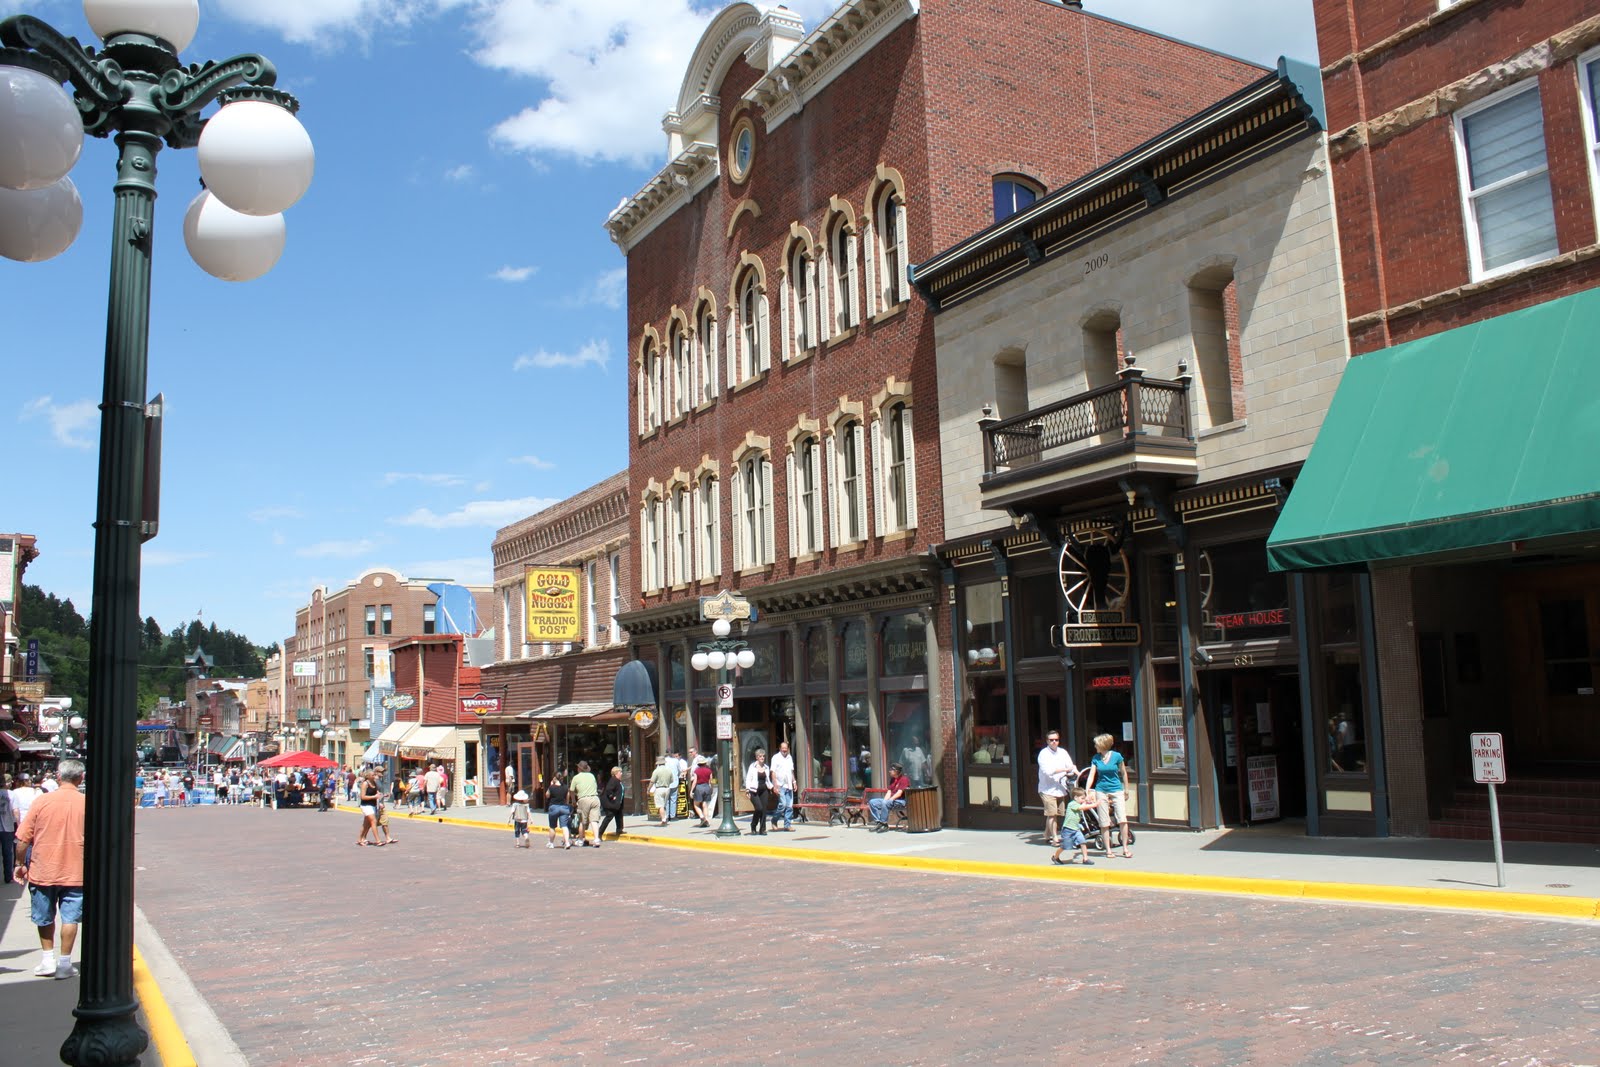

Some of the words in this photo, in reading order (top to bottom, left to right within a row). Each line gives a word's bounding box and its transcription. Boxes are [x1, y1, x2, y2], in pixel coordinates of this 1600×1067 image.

[1085, 253, 1108, 274] 2009
[537, 574, 570, 587] GOLD
[531, 592, 575, 609] NUGGET
[532, 616, 576, 626] TRADING
[1215, 614, 1244, 628] STEAK
[1249, 610, 1284, 624] HOUSE
[540, 626, 567, 634] POST
[1067, 629, 1112, 641] FRONTIER
[1114, 628, 1137, 640] CLUB
[1234, 655, 1254, 666] 681
[1092, 678, 1111, 687] LOOSE
[1113, 676, 1131, 686] SLOTS
[1480, 738, 1492, 747] NO
[1474, 749, 1501, 758] PARKING
